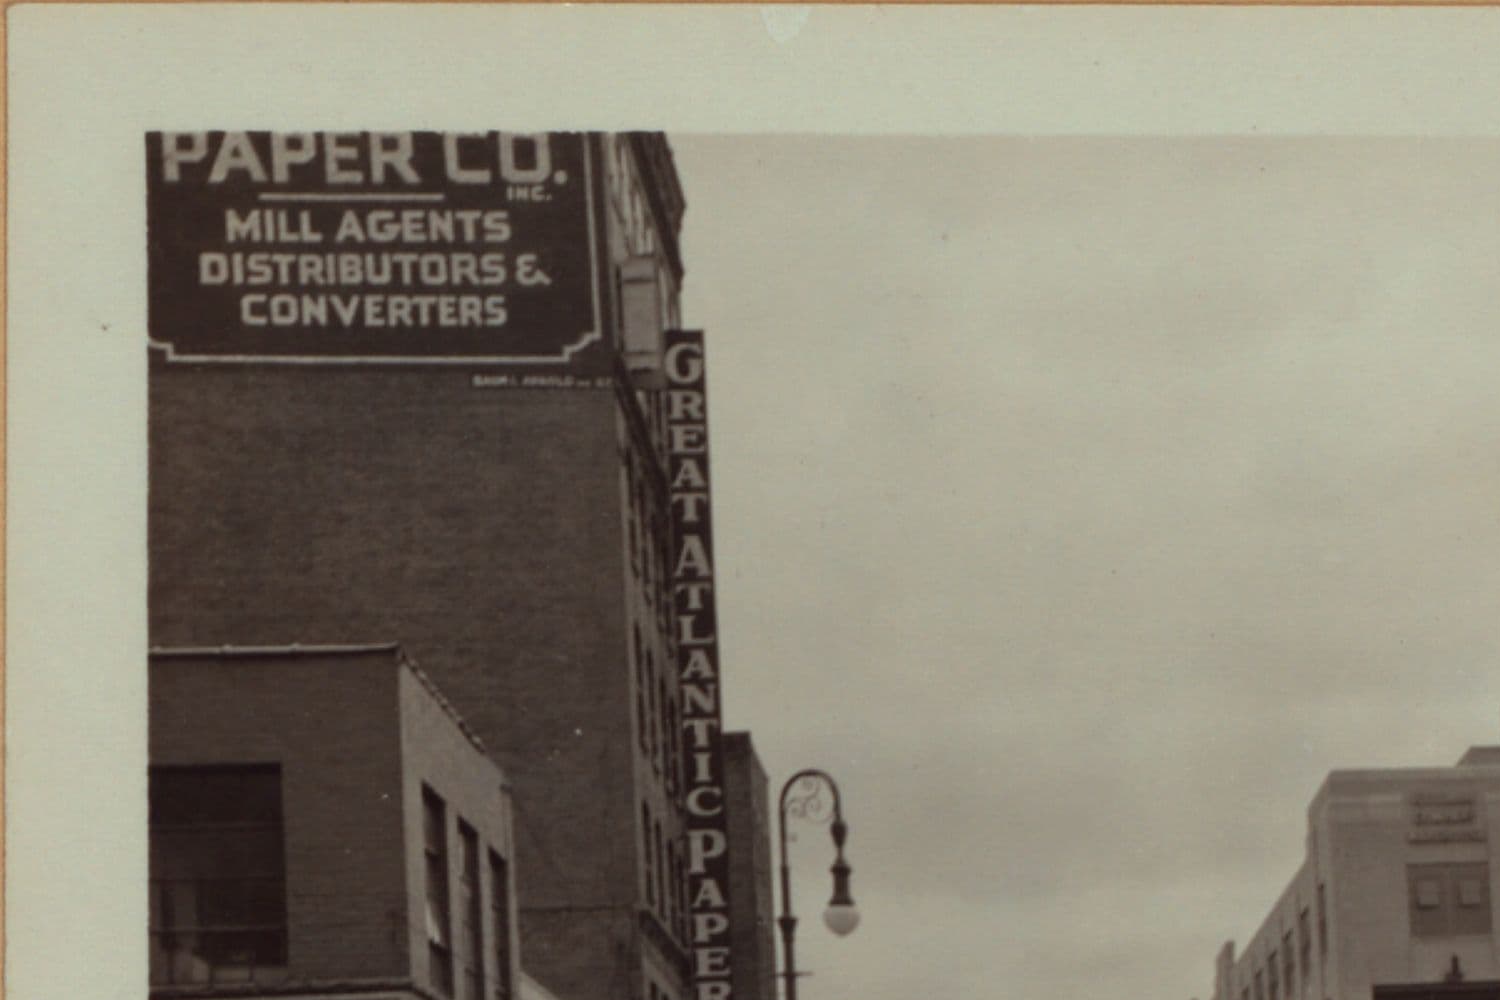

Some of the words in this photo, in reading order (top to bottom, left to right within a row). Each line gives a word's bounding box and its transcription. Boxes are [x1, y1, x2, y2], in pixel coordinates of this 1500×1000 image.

[163, 132, 419, 184] PAPER
[225, 209, 322, 243] MILL
[336, 210, 511, 242] AGENTS
[200, 252, 507, 286] DISTRIBUTORS
[515, 252, 552, 286] &
[240, 293, 507, 327] CONVERTERS
[665, 343, 707, 523] GREAT
[674, 535, 718, 817] ATLANTIC
